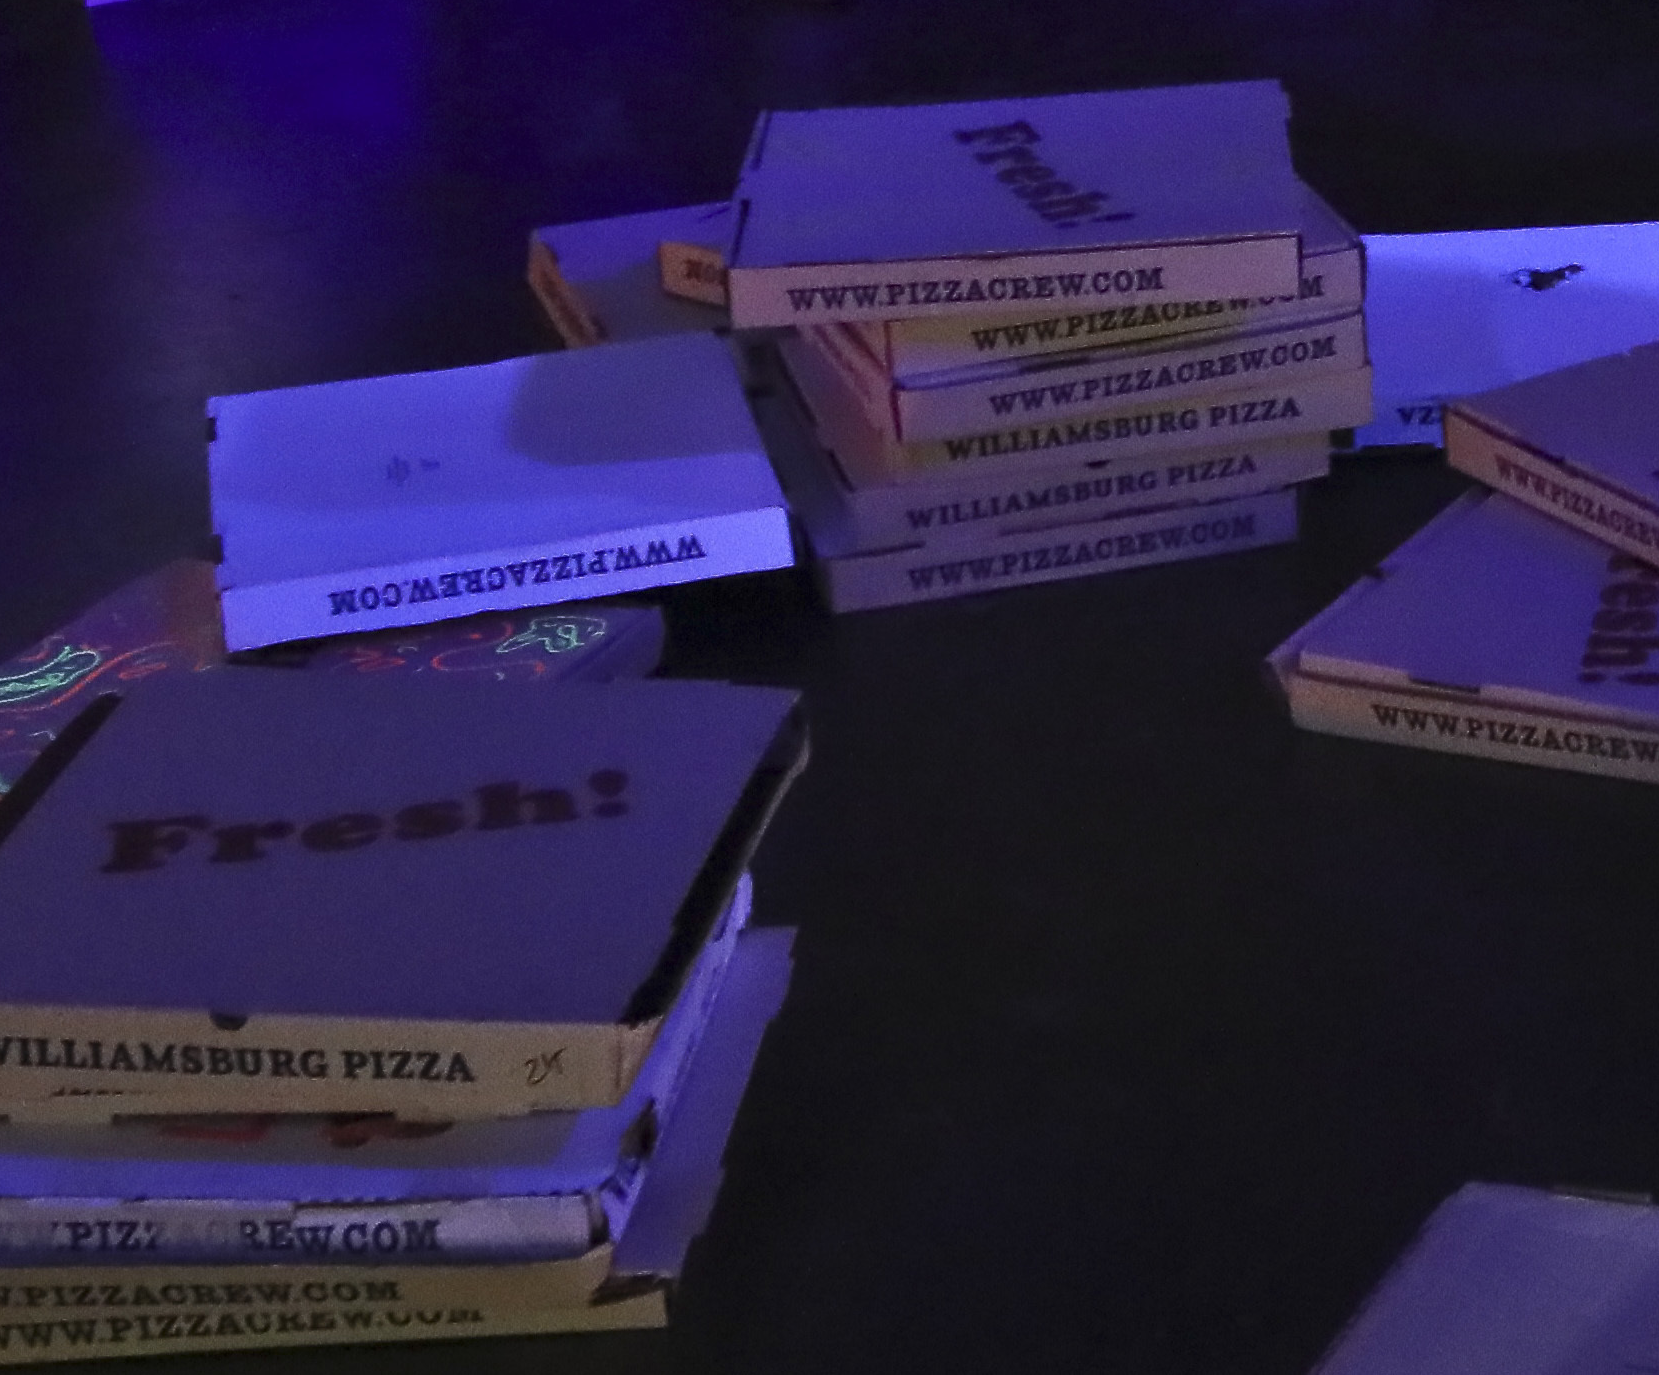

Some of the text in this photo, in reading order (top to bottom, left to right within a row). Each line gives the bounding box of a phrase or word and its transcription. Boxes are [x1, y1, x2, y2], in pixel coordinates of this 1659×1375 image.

[787, 266, 1164, 312] WWW.PIZZACREW.COM
[989, 336, 1337, 416] WWW.PIZZACREW.COM
[944, 395, 1302, 462] WILLIAMSBURG PIZZA
[906, 454, 1257, 531] WILLIAMSBURG PIZZA
[327, 534, 708, 616] WWW.PIZZACREW.COM
[908, 513, 1257, 592] WWW.PIZZACREW.COM
[98, 767, 630, 875] Fresh!
[341, 1048, 476, 1083] PIZZA
